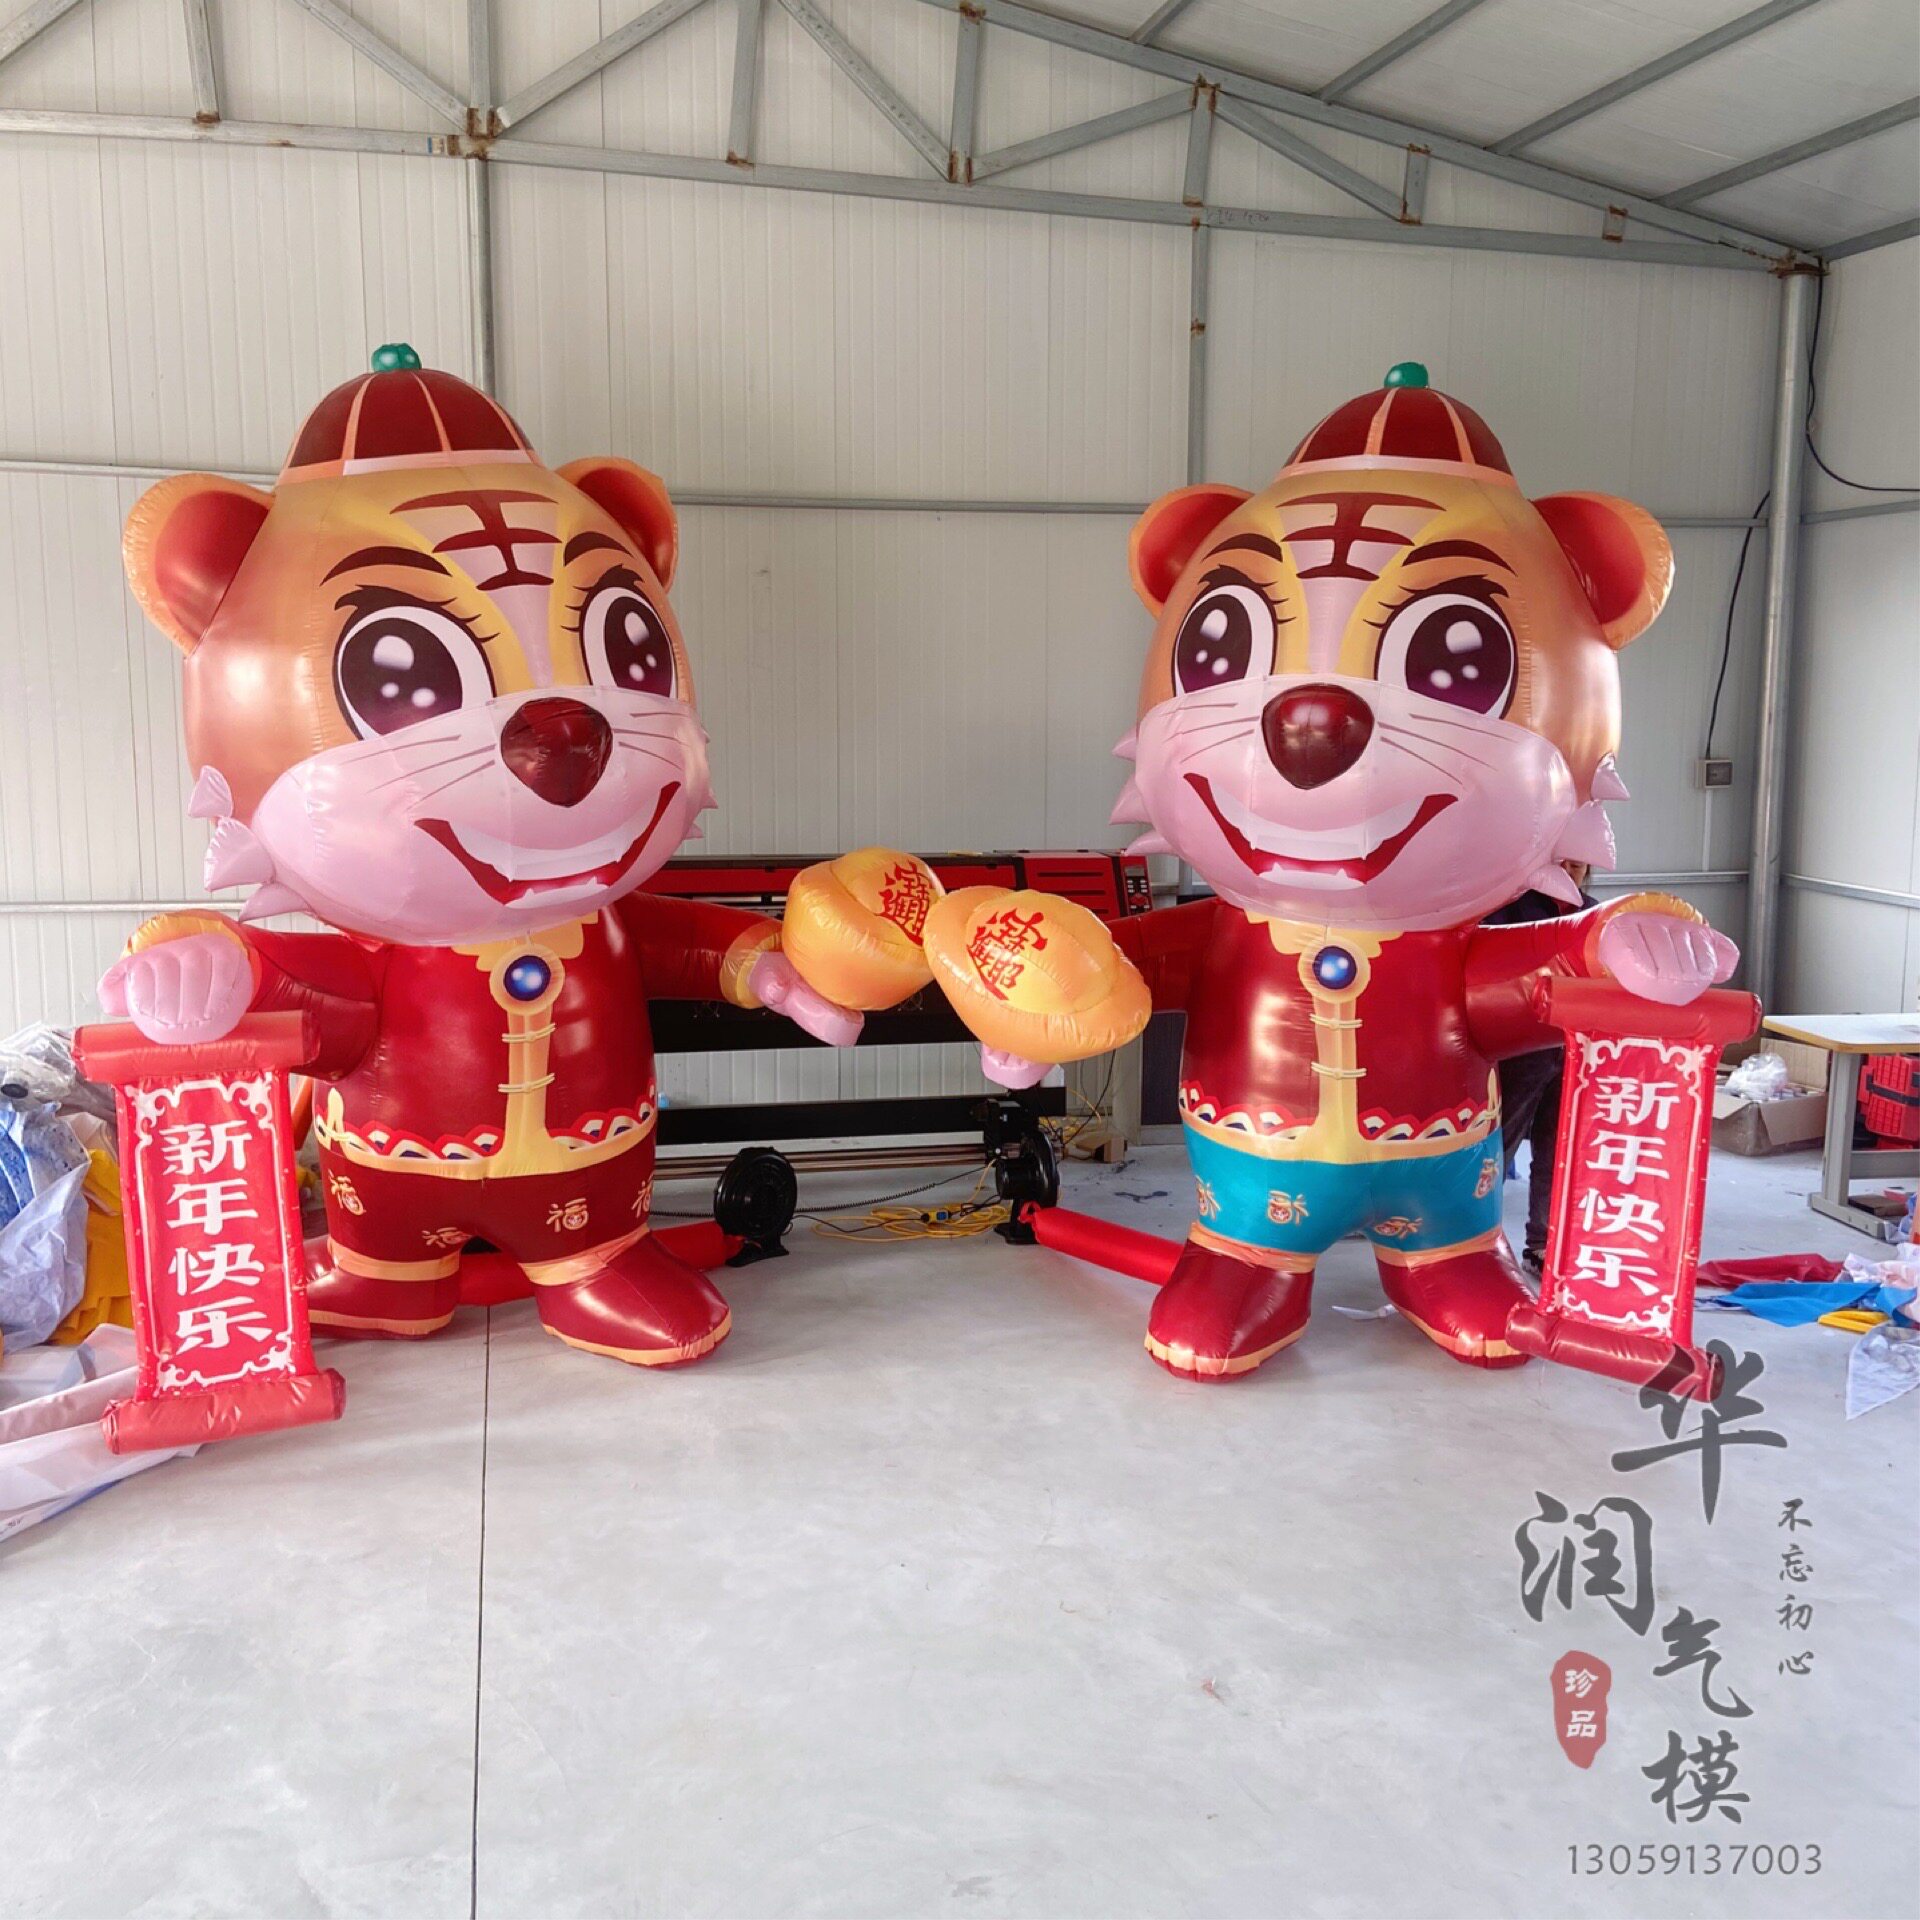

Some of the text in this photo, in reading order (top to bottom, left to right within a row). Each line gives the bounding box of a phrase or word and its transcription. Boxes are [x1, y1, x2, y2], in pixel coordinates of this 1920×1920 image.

[160, 1119, 273, 1356] 新年快乐
[1571, 1075, 1681, 1297] 新年快乐
